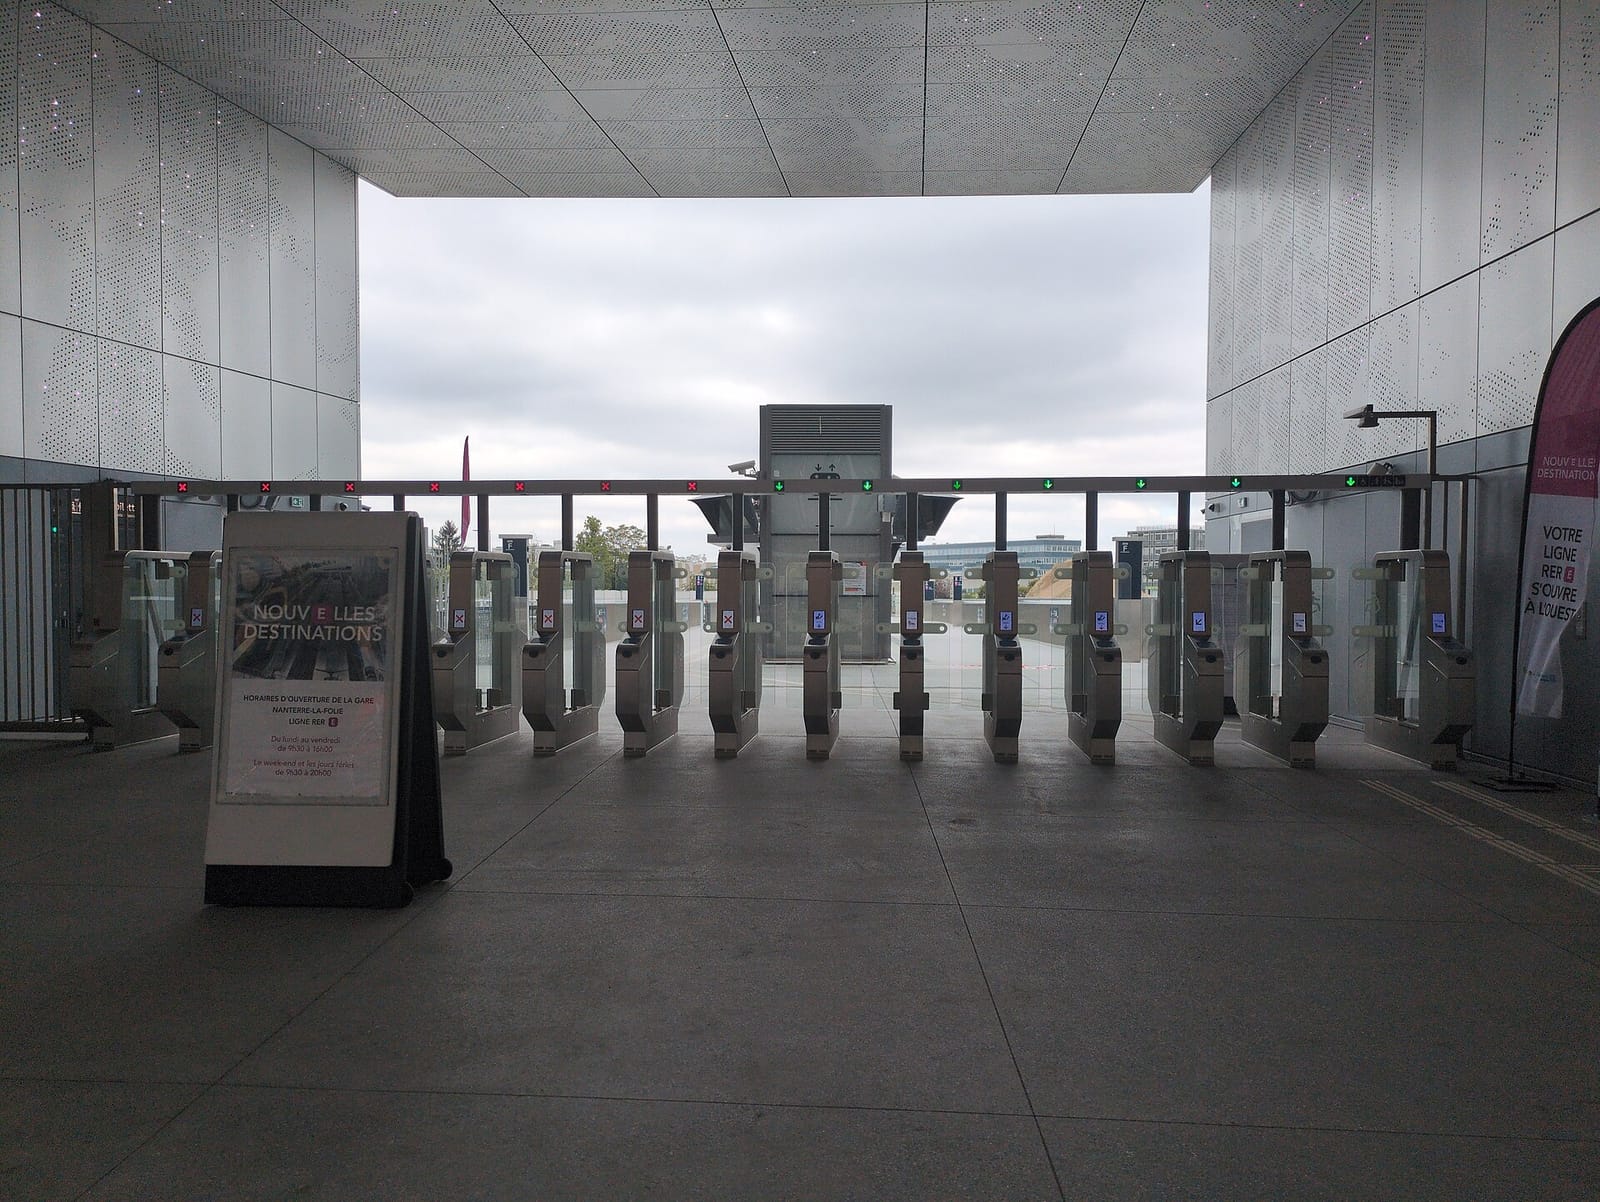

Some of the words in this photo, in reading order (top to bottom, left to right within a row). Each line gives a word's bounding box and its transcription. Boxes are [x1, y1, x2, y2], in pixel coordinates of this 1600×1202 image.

[1543, 525, 1583, 543] VOTRE
[1544, 545, 1577, 562] LIGNE
[1542, 564, 1562, 580] RER
[1532, 582, 1577, 602] S'OUVRE
[1524, 598, 1535, 614] À
[244, 624, 382, 641] DESTINATIONS
